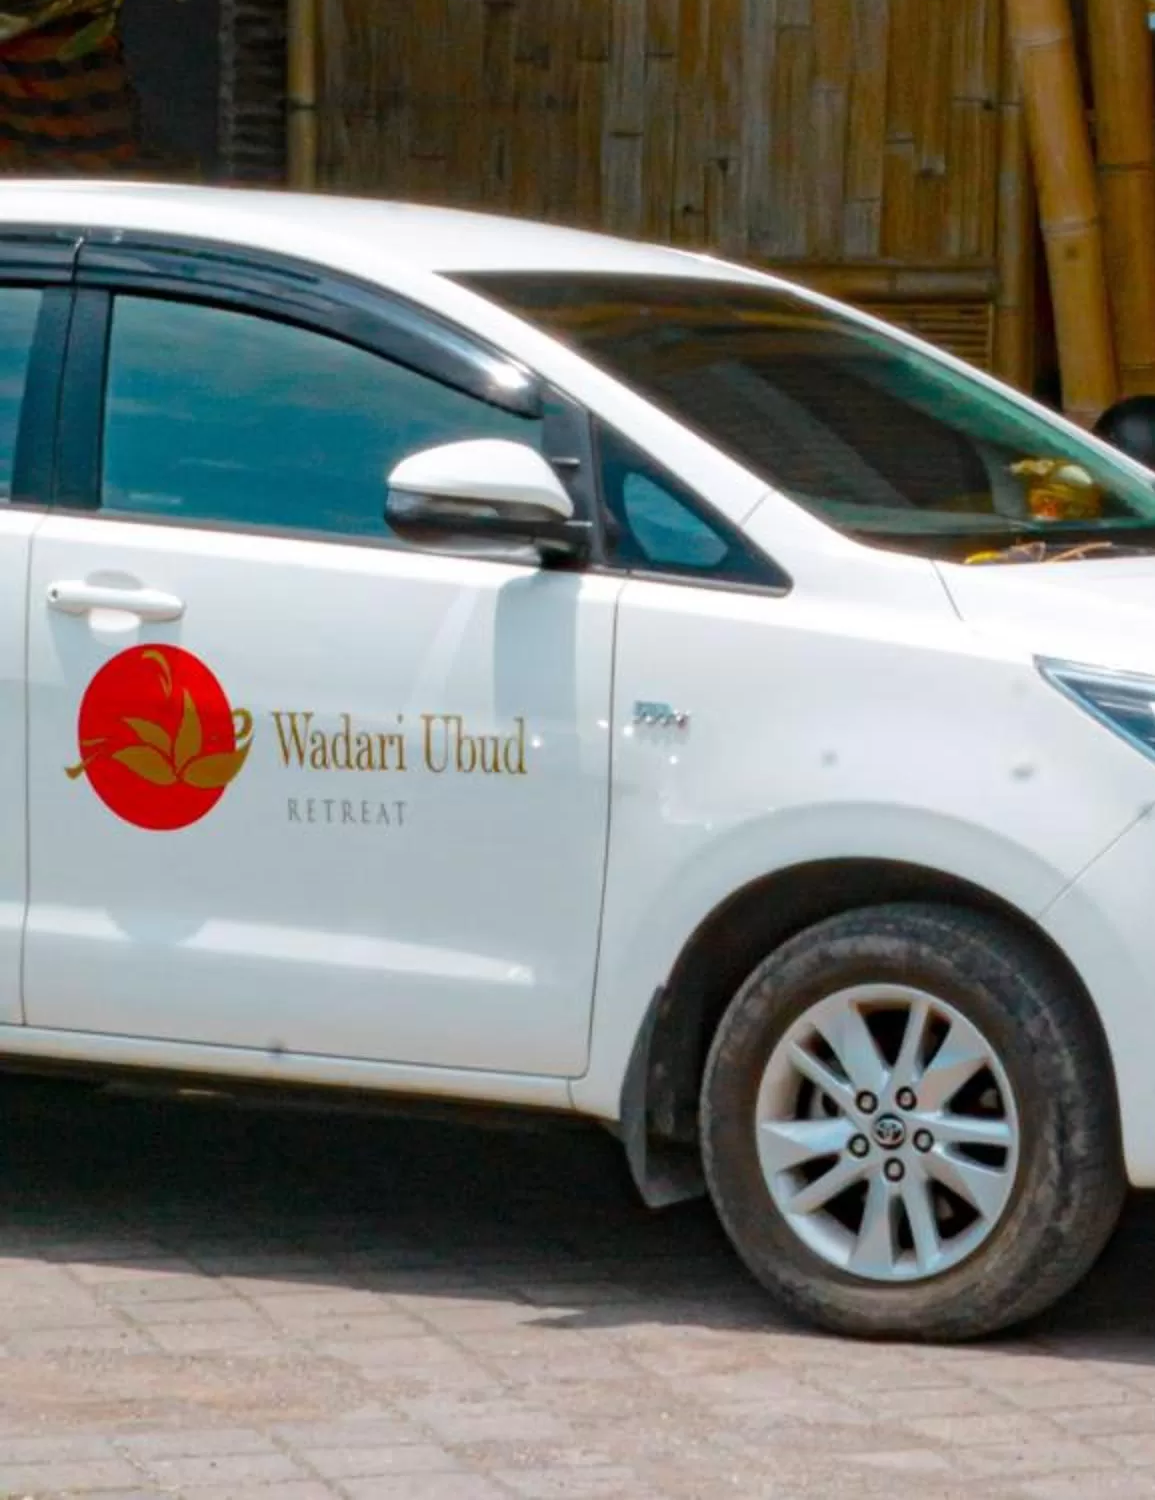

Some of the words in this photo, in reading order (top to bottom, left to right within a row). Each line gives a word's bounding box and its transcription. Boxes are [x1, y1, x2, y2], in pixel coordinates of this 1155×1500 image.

[271, 710, 407, 772] Wadari
[420, 713, 528, 775] Ubud
[286, 797, 407, 827] RETREAT
